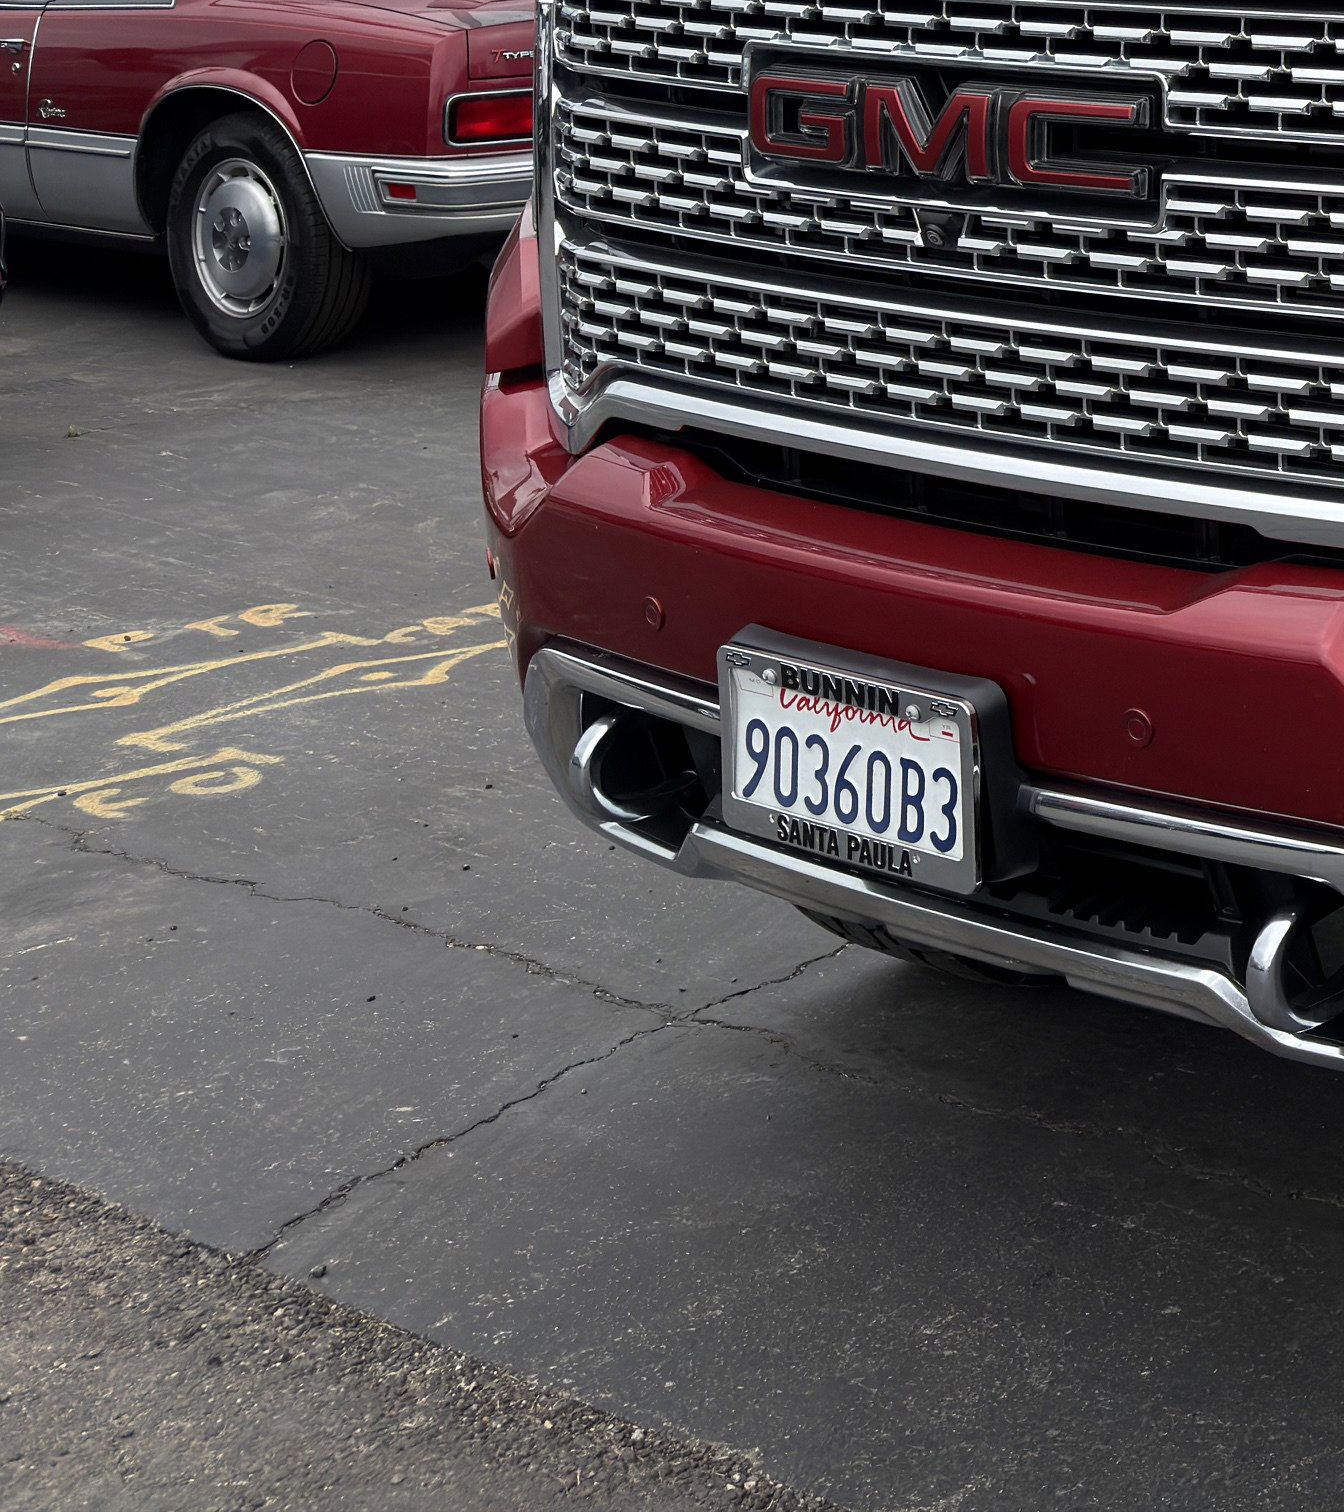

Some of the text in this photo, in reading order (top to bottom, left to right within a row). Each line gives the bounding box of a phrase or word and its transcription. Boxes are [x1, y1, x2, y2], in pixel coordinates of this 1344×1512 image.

[750, 73, 1148, 199] GMC
[780, 662, 901, 718] BUNNIN
[742, 718, 958, 853] 90360B3
[776, 814, 913, 878] SANTA PAULA
